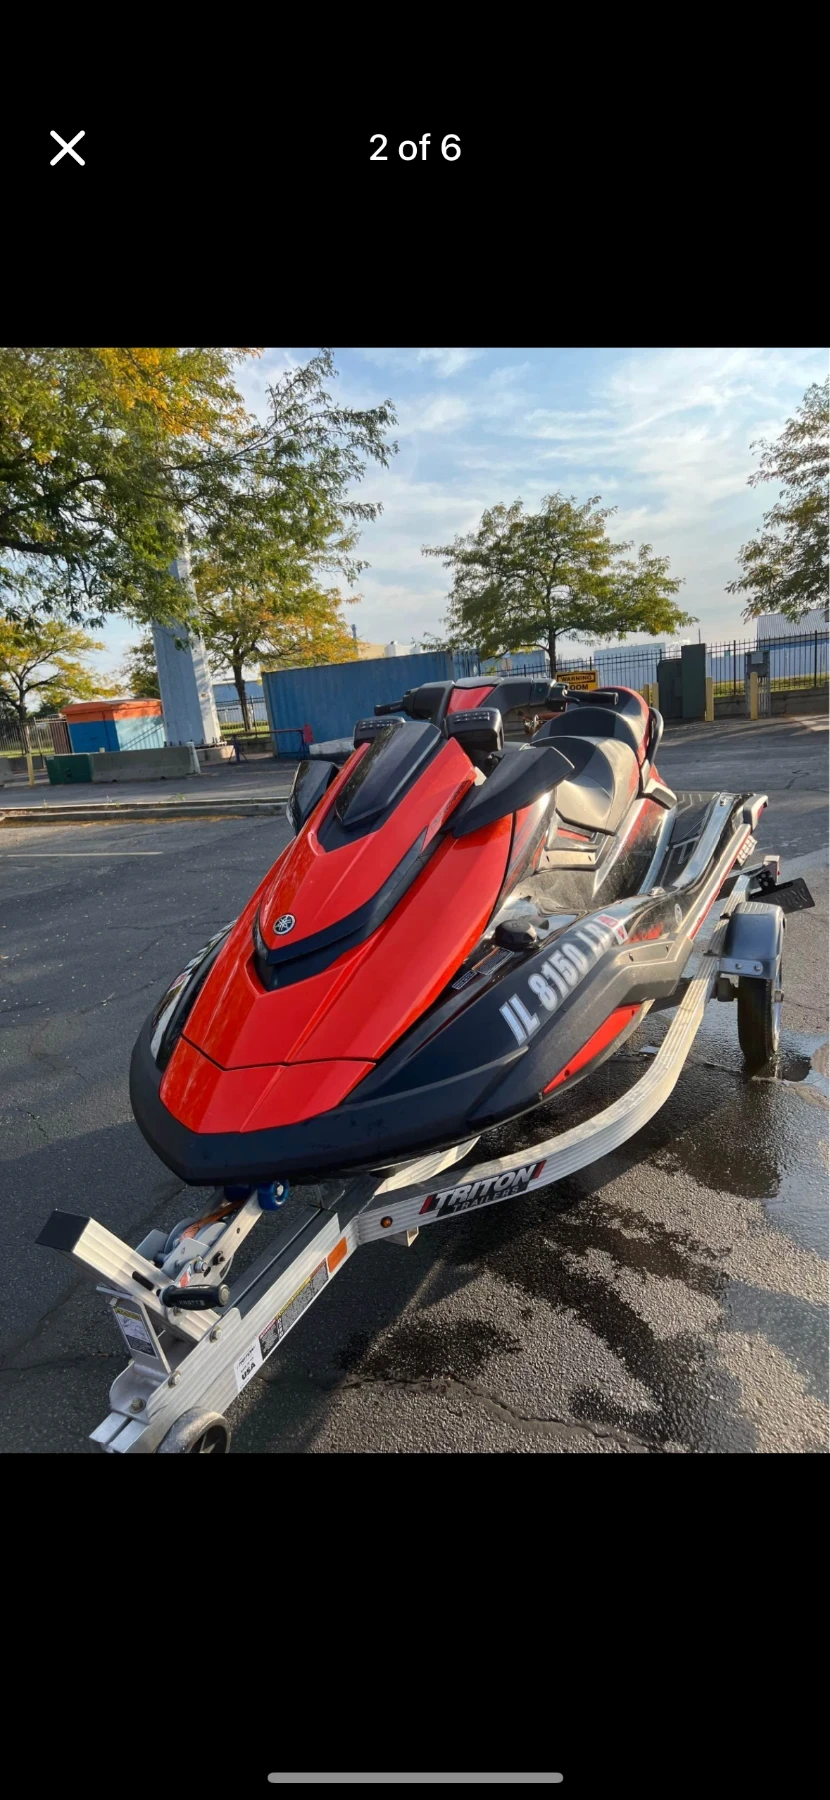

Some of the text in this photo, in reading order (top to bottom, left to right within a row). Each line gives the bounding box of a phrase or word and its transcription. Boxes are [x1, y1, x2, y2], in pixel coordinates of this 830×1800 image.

[499, 993, 541, 1046] IL
[528, 943, 589, 1011] 8150
[435, 1164, 537, 1210] TRITON
[453, 1186, 519, 1213] TRAILERS
[241, 1362, 256, 1380] USA
